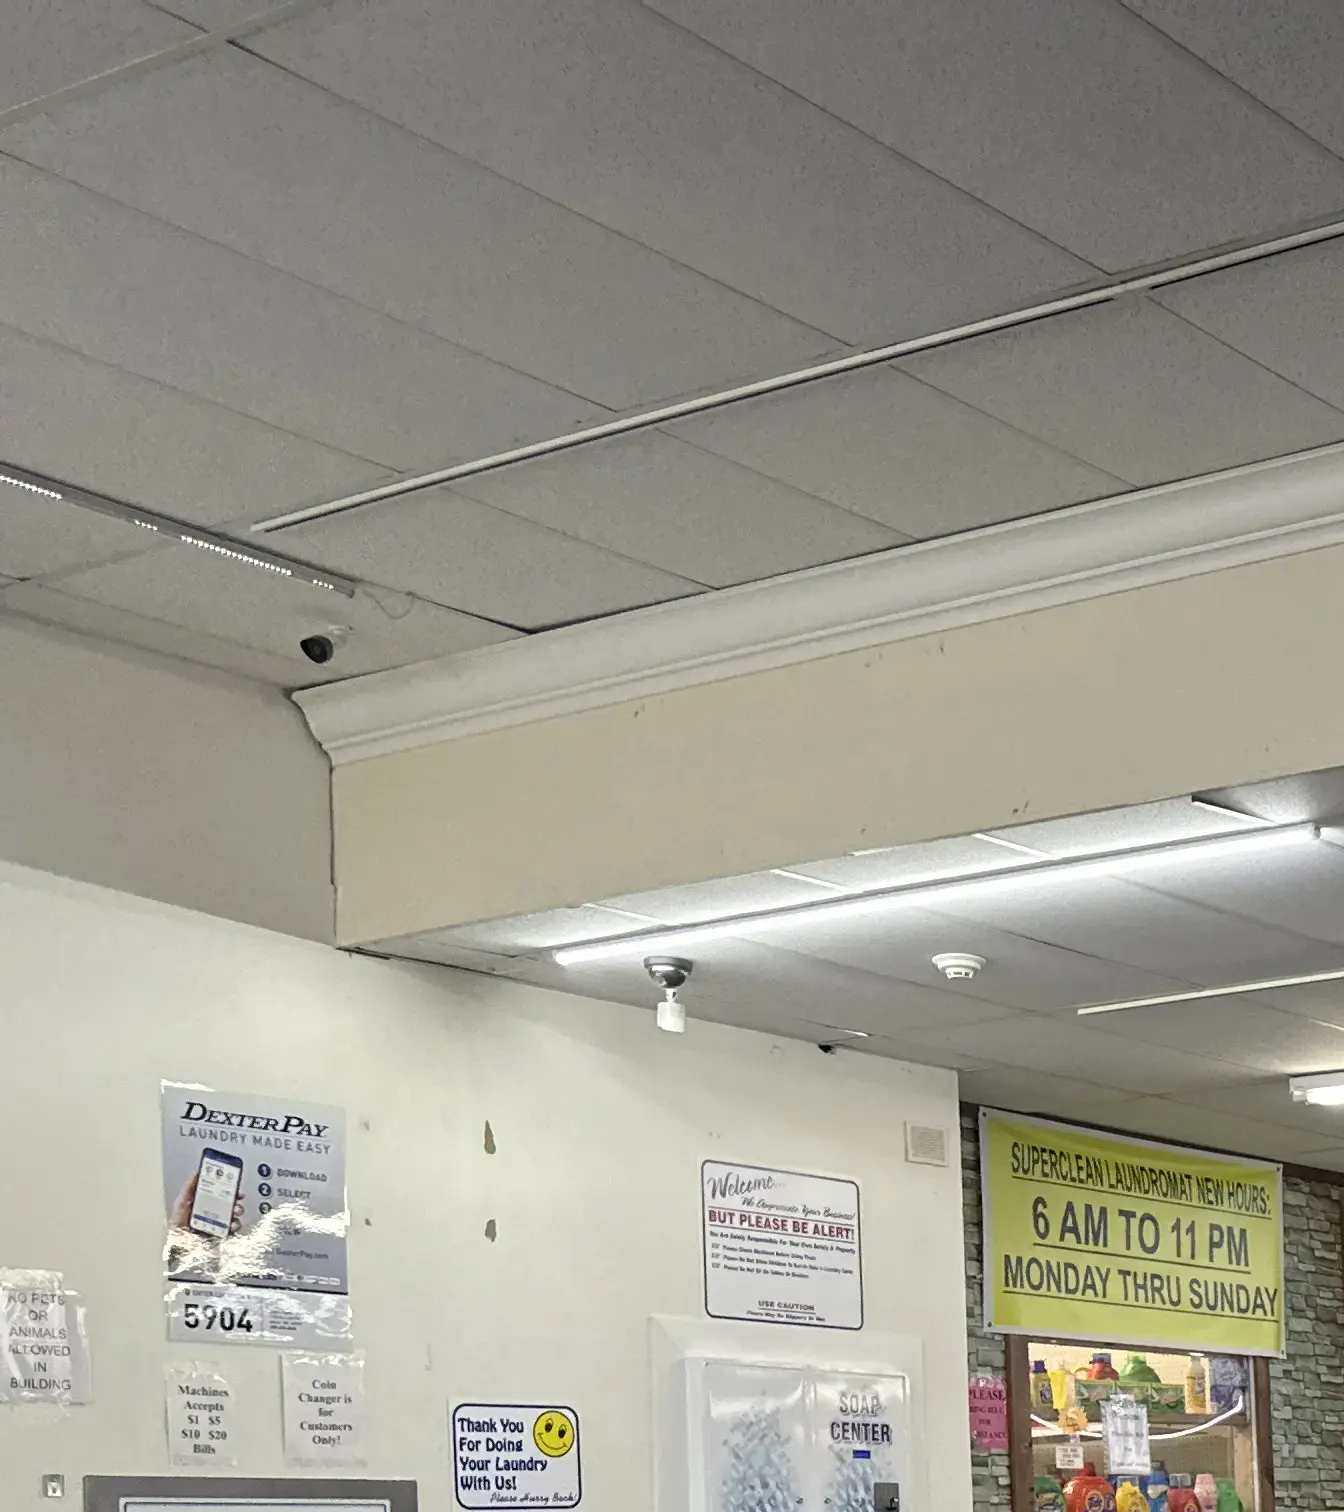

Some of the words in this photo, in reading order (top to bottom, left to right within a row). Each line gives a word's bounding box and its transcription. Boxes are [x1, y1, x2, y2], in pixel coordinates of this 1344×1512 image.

[180, 1126, 247, 1145] LAUNDRY
[252, 1136, 291, 1150] MADE
[297, 1141, 330, 1155] EASY
[277, 1169, 327, 1182] DOWNLOAD
[1011, 1141, 1102, 1187] SUPERCLEAN
[1108, 1162, 1192, 1204] LAUNDROMAT
[1196, 1176, 1224, 1206] NEW
[1228, 1180, 1271, 1215] HOURS:
[709, 1210, 735, 1225] BUT
[740, 1214, 789, 1231] PLEASE
[793, 1221, 809, 1234] BE
[813, 1225, 855, 1240] ALERT!
[1032, 1195, 1050, 1240] 6
[1059, 1201, 1108, 1248] AM
[1118, 1208, 1160, 1255] TO
[1171, 1217, 1196, 1260] 11
[1208, 1223, 1249, 1267] PM
[1004, 1255, 1111, 1298] MONDAY
[1118, 1269, 1181, 1307] THRU
[1189, 1278, 1277, 1317] SUNDAY
[758, 1300, 774, 1308] USE
[777, 1302, 815, 1311] CAUTION
[28, 1310, 48, 1321] OR
[184, 1303, 252, 1332] 5904
[9, 1326, 67, 1339] ANIMALS
[9, 1344, 71, 1356] ALLOWED
[34, 1362, 47, 1372] IN
[10, 1377, 71, 1390] BUILDING
[312, 1380, 336, 1390] Coin
[178, 1385, 229, 1397] Machines
[298, 1393, 341, 1405] Changer
[344, 1394, 352, 1403] is
[840, 1393, 880, 1416] SOAP
[184, 1401, 224, 1413] Accepts
[318, 1408, 333, 1417] for
[188, 1415, 199, 1424] $1
[208, 1415, 220, 1425] $5
[300, 1421, 352, 1431] Customers
[458, 1417, 497, 1432] Thank
[500, 1419, 524, 1433] You
[181, 1429, 200, 1439] $10
[208, 1430, 227, 1440] $20
[831, 1422, 891, 1442] CENTER
[312, 1435, 341, 1447] Only!
[460, 1437, 481, 1452] For
[486, 1438, 523, 1452] Doing
[193, 1443, 216, 1454] Bills
[459, 1456, 491, 1471] Your
[496, 1457, 548, 1471] Laundry
[460, 1475, 490, 1490] With
[495, 1476, 517, 1490] Us!
[490, 1492, 517, 1503] Please
[520, 1492, 549, 1505] Hurry
